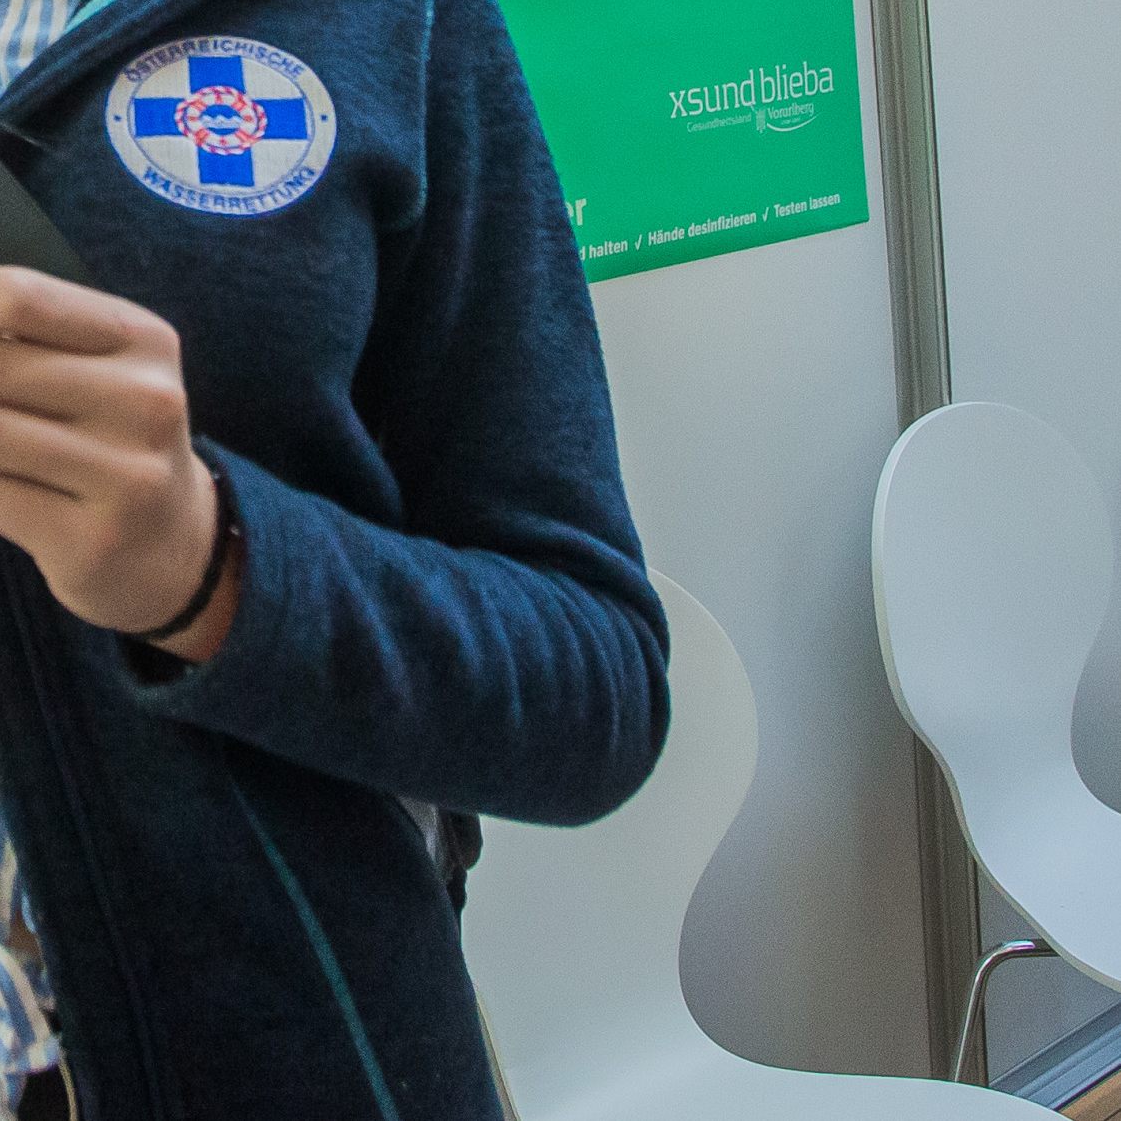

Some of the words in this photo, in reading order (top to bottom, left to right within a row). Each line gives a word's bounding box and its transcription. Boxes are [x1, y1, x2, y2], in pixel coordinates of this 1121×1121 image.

[767, 102, 815, 119] Vorarlberg
[143, 167, 317, 213] WASSERRETTUNG
[589, 237, 628, 259] halten
[648, 227, 685, 246] Hände
[688, 210, 756, 237] desinfizieren
[774, 199, 807, 218] Testen
[809, 193, 841, 211] lassen
